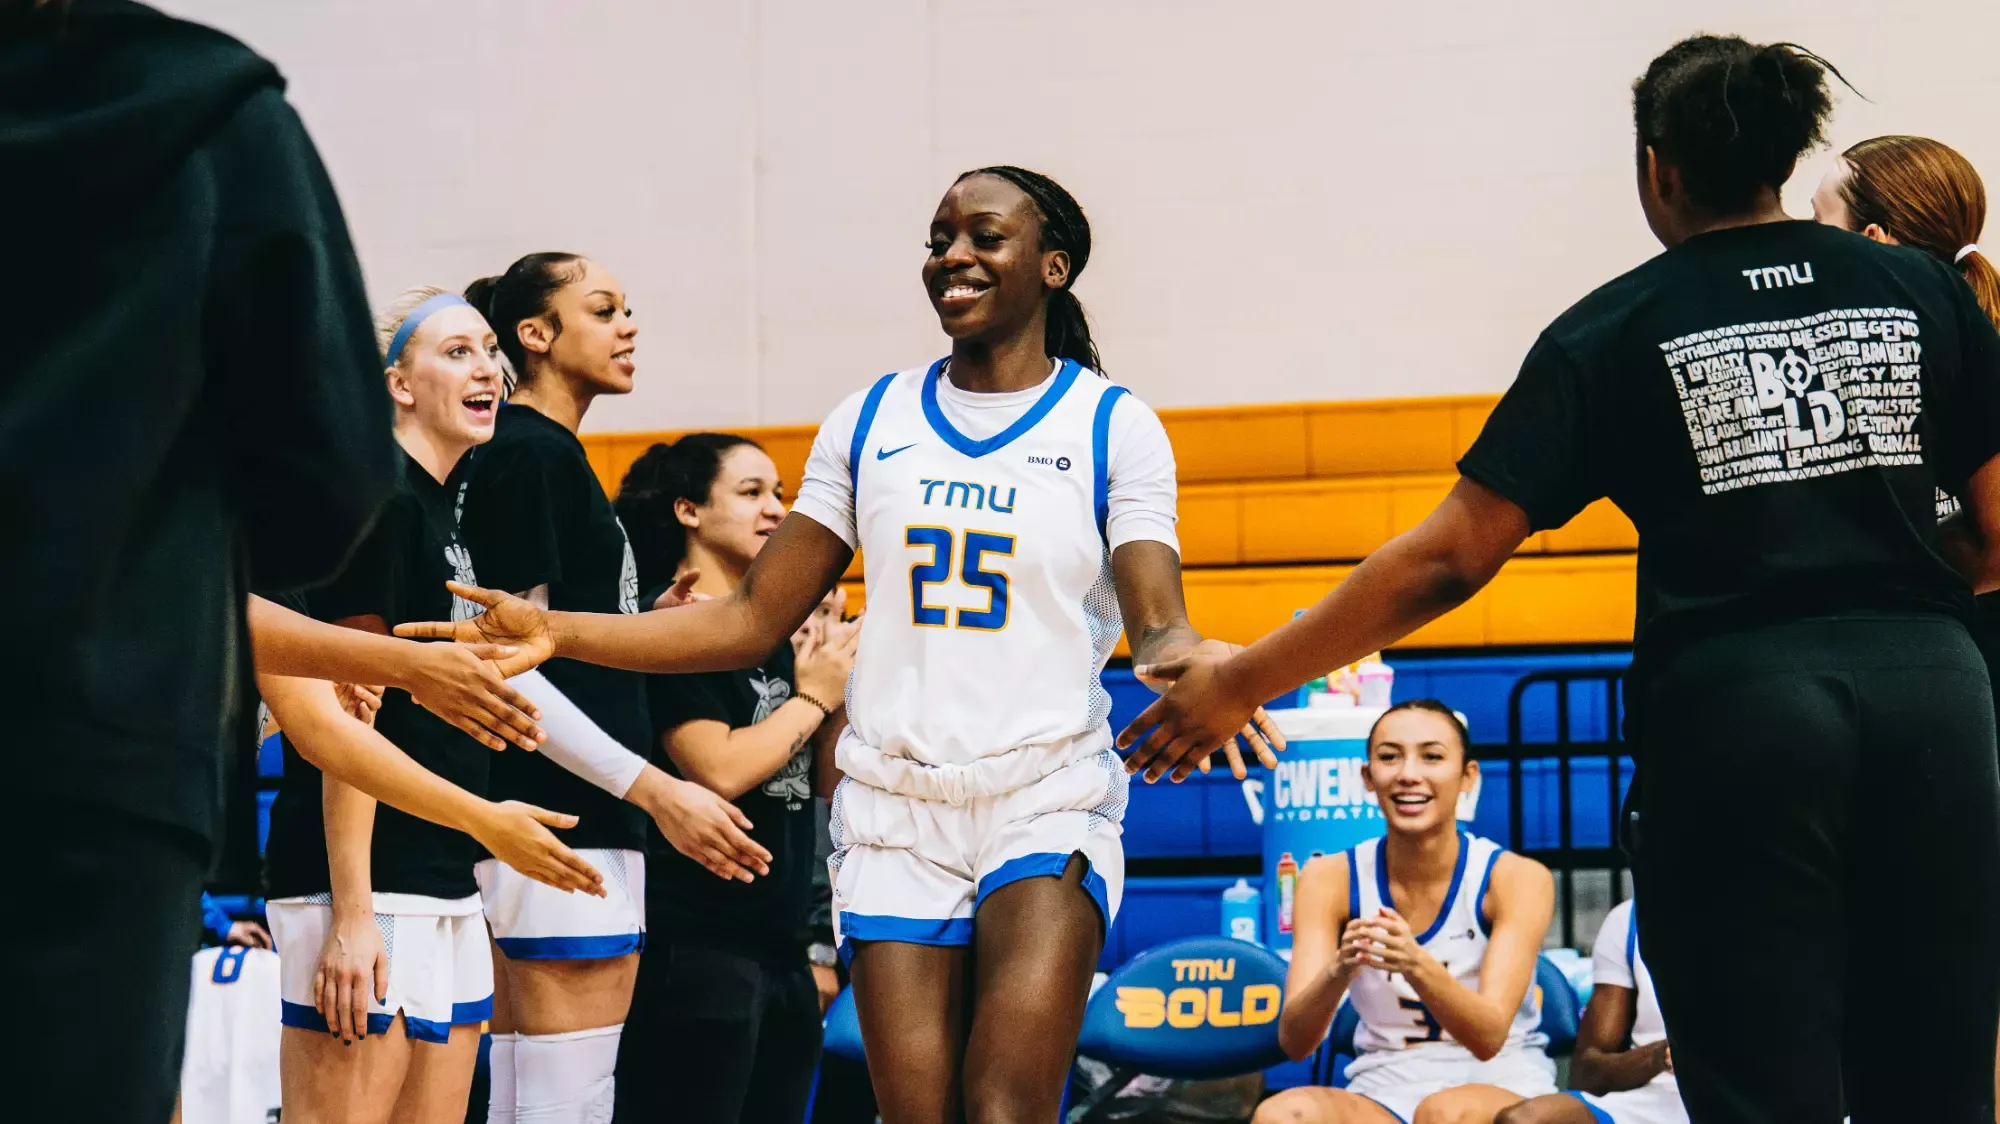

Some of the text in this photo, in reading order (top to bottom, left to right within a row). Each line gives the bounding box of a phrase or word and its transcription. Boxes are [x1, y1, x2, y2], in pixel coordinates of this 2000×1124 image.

[1742, 262, 1814, 290] TMU
[1665, 320, 1920, 367] BROTHERHOOD DEFEND BLESSED LEGEND
[1807, 341, 1859, 364] BELOVED
[1861, 341, 1921, 364] BRAVERY
[1686, 352, 1744, 382] LOYALTY
[1706, 366, 1751, 384] BEAUTIFUL
[1820, 356, 1862, 373] DEVOTED
[1689, 377, 1753, 398] OVERJOYED
[1822, 367, 1886, 391] LEGACY
[1681, 386, 1755, 411] LIKE MINDED
[1847, 398, 1922, 416] OPTIMISTIC
[1698, 396, 1760, 427] DREAM
[1684, 409, 1706, 450] DESIRE
[1704, 421, 1743, 447] LEADER
[1847, 415, 1917, 436] DESTINY
[1723, 428, 1786, 459] BRILLIANT
[1028, 456, 1053, 465] BMO
[1700, 455, 1783, 482] OUTSTANDING
[1786, 438, 1863, 468] LEARNING
[919, 478, 1016, 514] TMU
[904, 523, 1017, 632] 25
[1171, 958, 1236, 981] TMU
[1115, 984, 1281, 1028] BOLD
